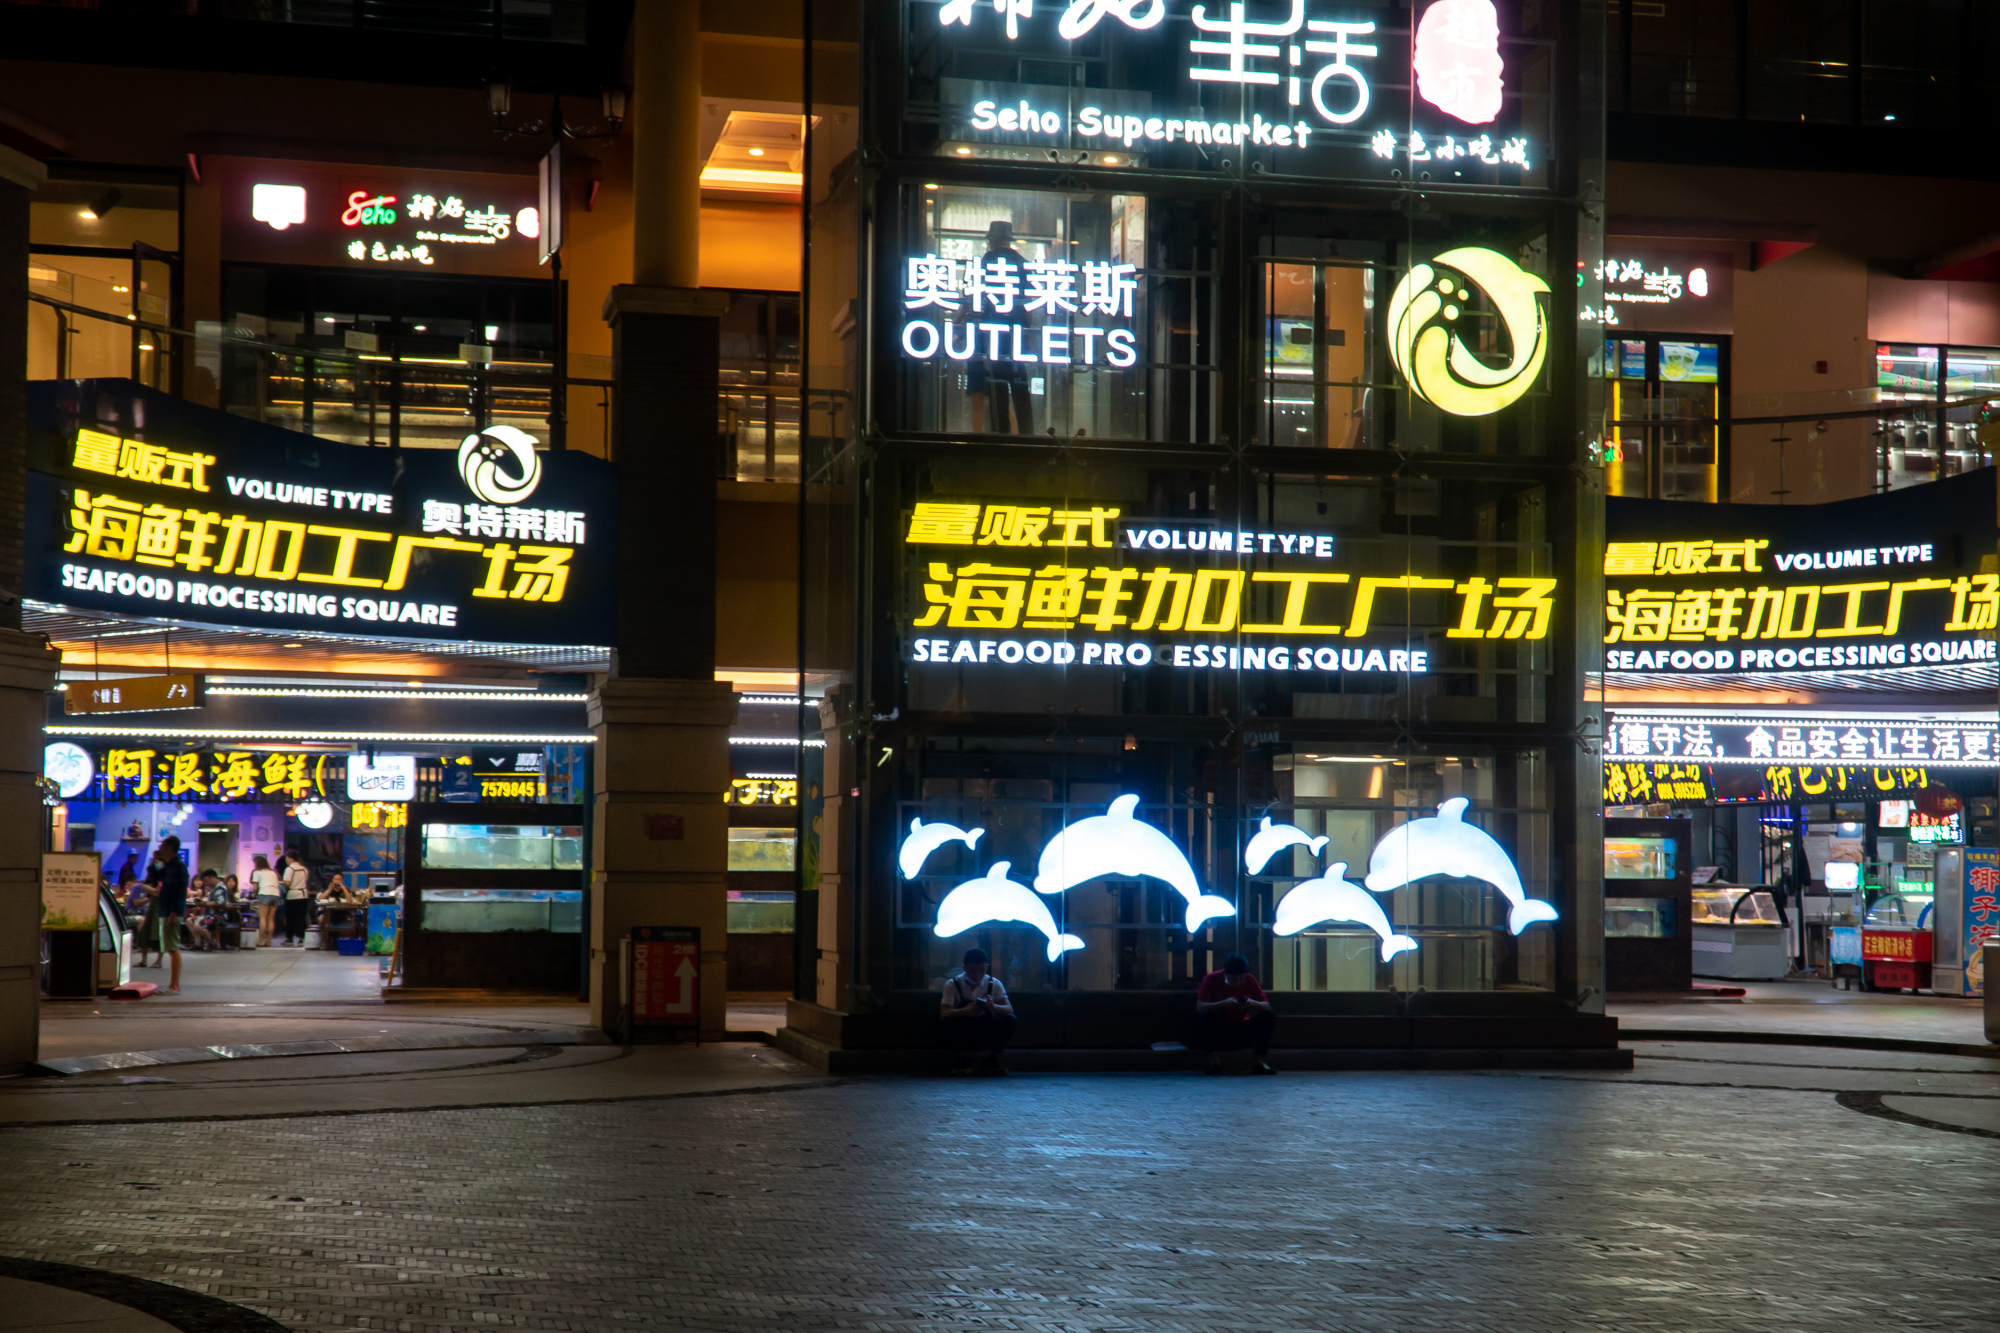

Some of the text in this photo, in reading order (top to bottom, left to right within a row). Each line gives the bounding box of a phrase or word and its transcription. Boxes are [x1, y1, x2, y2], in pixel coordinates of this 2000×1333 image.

[971, 100, 1312, 148] Seho Supermarket
[1372, 129, 1530, 170] 特色小吃城
[341, 191, 398, 227] Seho
[905, 253, 1137, 317] 奥特莱斯
[903, 320, 1136, 366] OUTLETS
[73, 429, 216, 492] 量贩式
[227, 477, 392, 513] VOLUME TYPE
[422, 500, 585, 545] 奥特莱斯
[906, 503, 1120, 547] 量贩式
[1127, 529, 1333, 557] VOLUME TYPE
[64, 488, 574, 602] 海鲜加工广场
[1604, 540, 1769, 575] 量贩式
[1775, 545, 1933, 571] VOLUME TYPE
[62, 564, 458, 627] SEAFOOD PROCESSING SQUARE
[914, 563, 1557, 640] 海鲜加工广场
[1604, 573, 1999, 643] 海鲜加工广场
[914, 639, 1075, 664] SEAFOOD
[1298, 647, 1427, 671] SQUARE
[1607, 639, 1997, 669] SEAFOOD PROCESSING SQUARE
